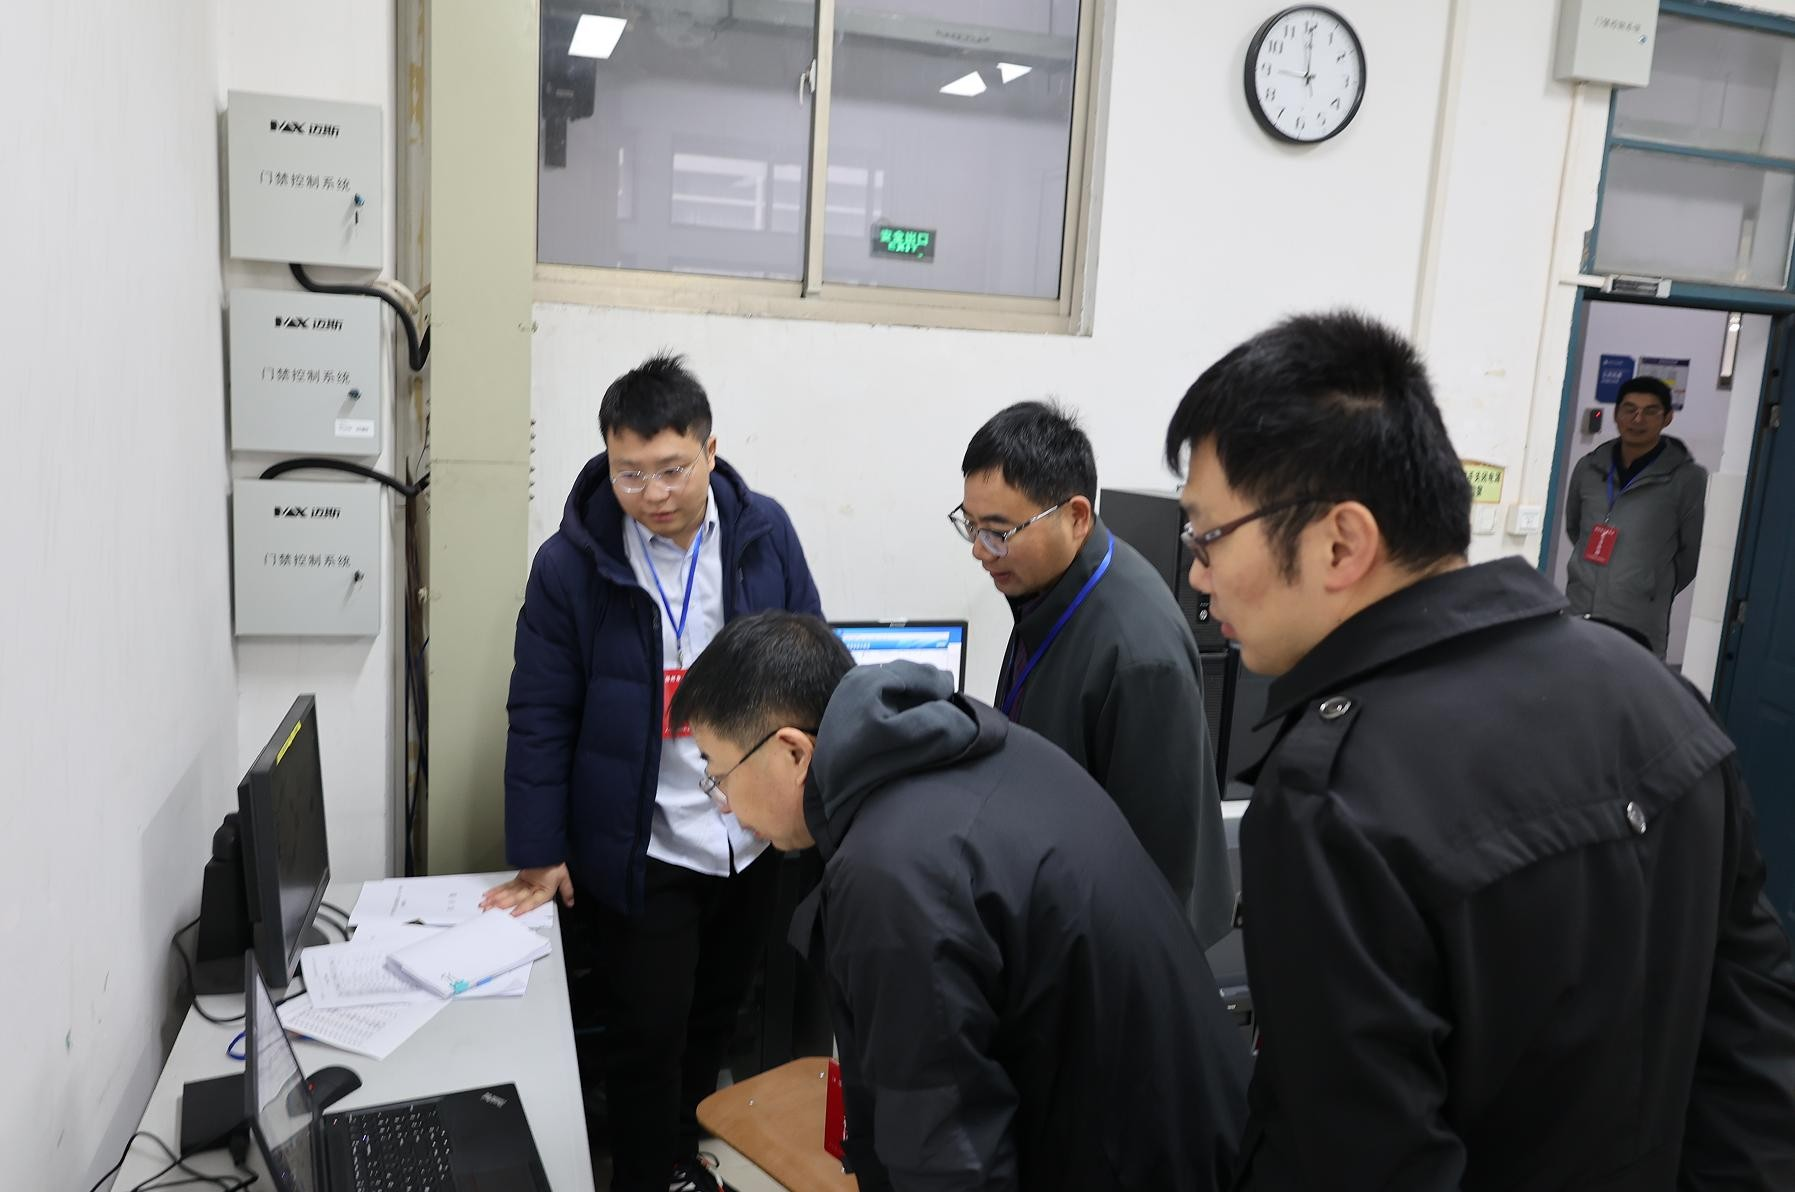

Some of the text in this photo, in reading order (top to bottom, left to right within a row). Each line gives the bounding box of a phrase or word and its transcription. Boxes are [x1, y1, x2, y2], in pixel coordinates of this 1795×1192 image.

[1283, 24, 1295, 39] 11
[1268, 40, 1284, 54] 10
[259, 168, 351, 192] 门禁控制系统
[261, 366, 351, 385] 门禁控制系统
[264, 552, 351, 569] 门禁控制系统
